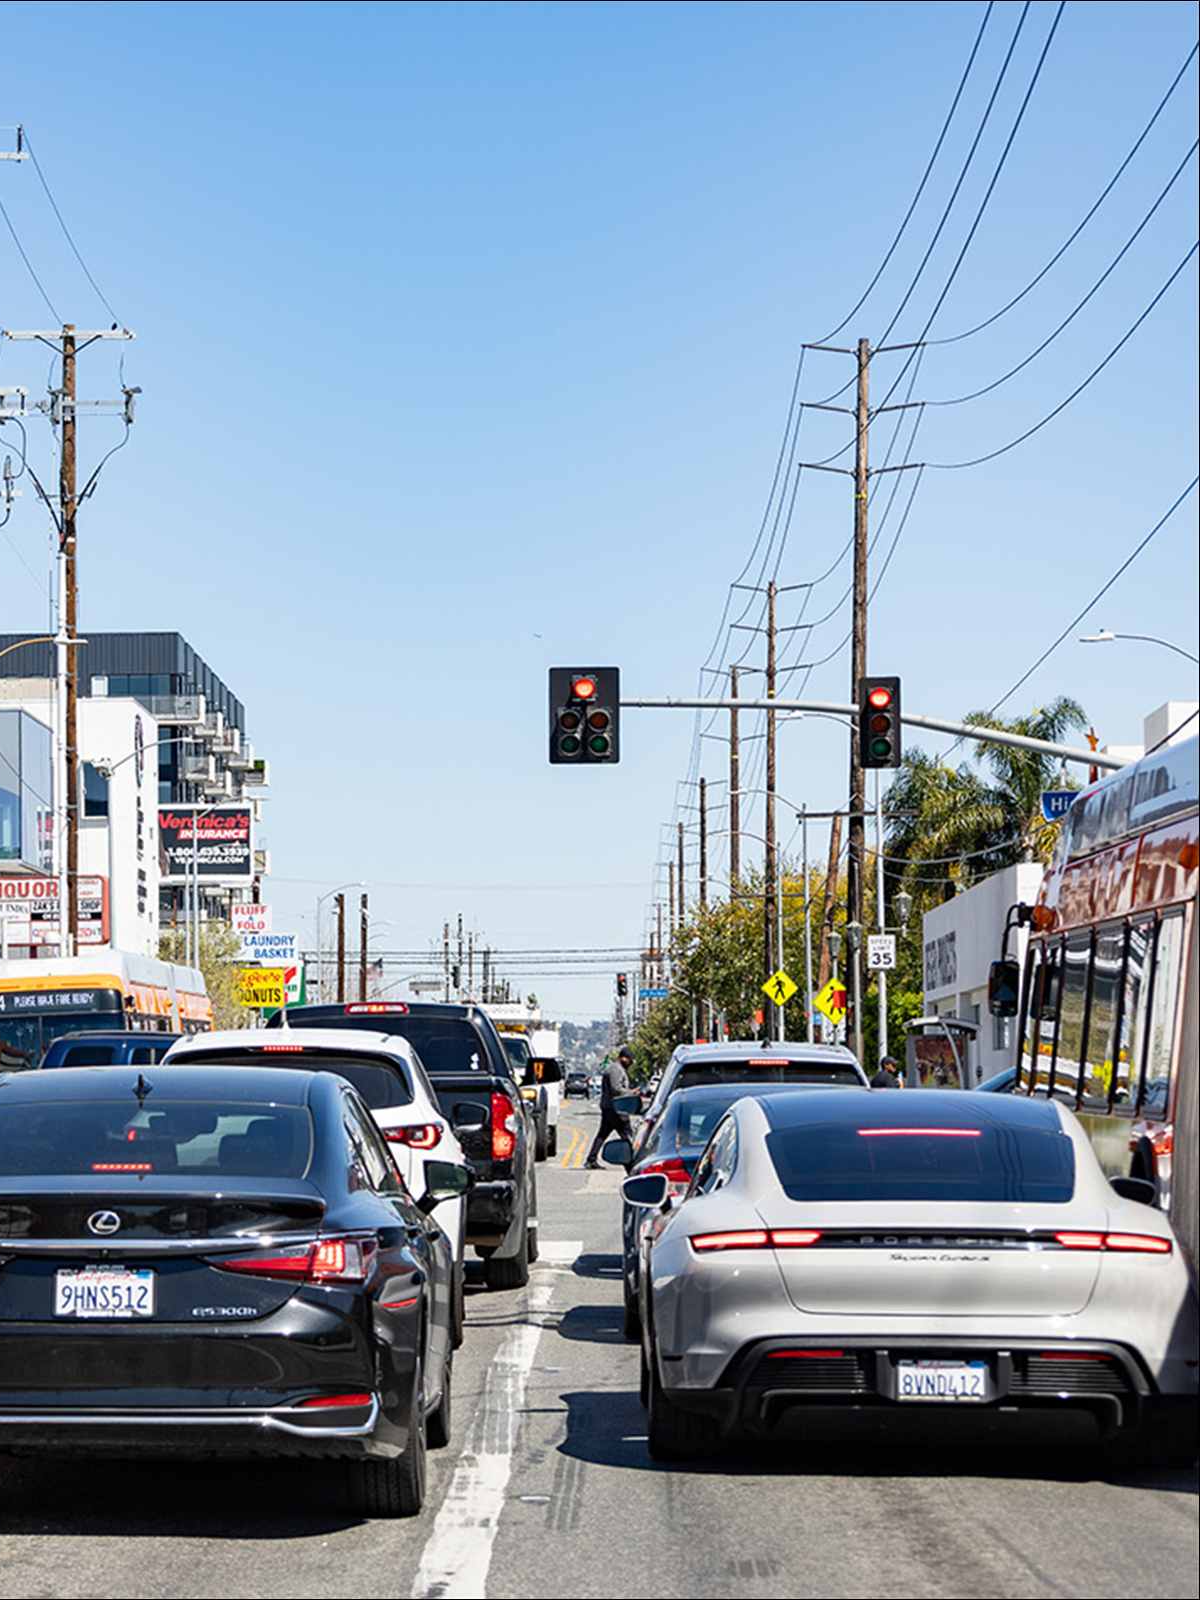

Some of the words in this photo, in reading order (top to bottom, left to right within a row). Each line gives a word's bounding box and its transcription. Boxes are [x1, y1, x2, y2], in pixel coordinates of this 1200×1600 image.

[1051, 796, 1069, 811] Hi
[158, 813, 250, 829] Veronica's
[179, 829, 247, 839] INSURANCE
[80, 900, 101, 911] SHOP
[234, 905, 267, 916] FLUFF
[237, 921, 266, 931] FOLD
[244, 935, 296, 947] LAUNDRY
[253, 948, 295, 959] BASKET
[872, 952, 892, 965] 35
[61, 1285, 149, 1309] 9HNS512
[902, 1373, 981, 1396] 8VND412
